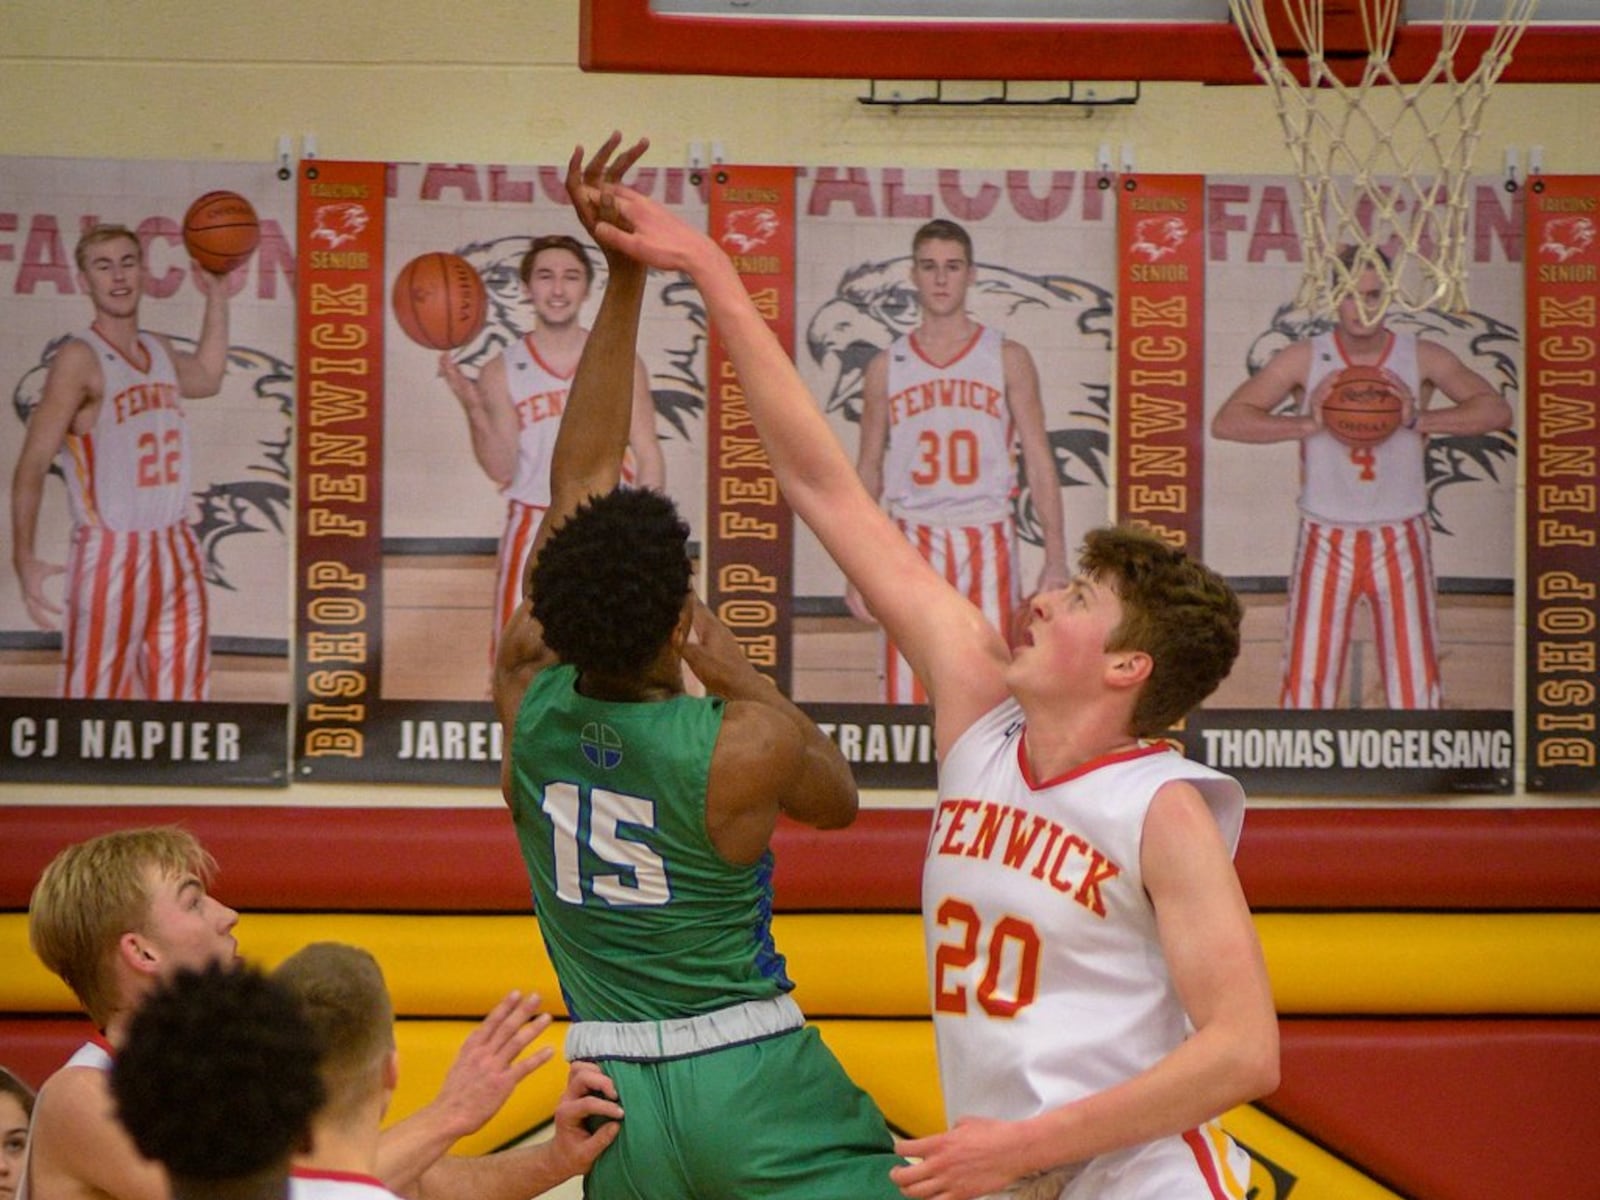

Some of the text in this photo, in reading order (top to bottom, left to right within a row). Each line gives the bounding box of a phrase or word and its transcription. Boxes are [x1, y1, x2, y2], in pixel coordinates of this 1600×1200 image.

[310, 252, 369, 270] SENIOR
[732, 256, 781, 274] ENIOR
[1130, 264, 1188, 282] SENIOR
[1539, 264, 1597, 282] SENIOR
[889, 379, 1002, 425] FENWICK
[137, 430, 181, 486] 22
[911, 429, 978, 485] 30
[305, 283, 368, 757] BISHOP FENWICK
[1537, 296, 1597, 767] BISHOP FENWICK
[12, 717, 241, 761] CJ NAPIER
[1201, 729, 1334, 768] THOMAS
[1338, 730, 1512, 768] VOGELSANG
[541, 780, 672, 906] 15
[934, 896, 1042, 1019] 20
